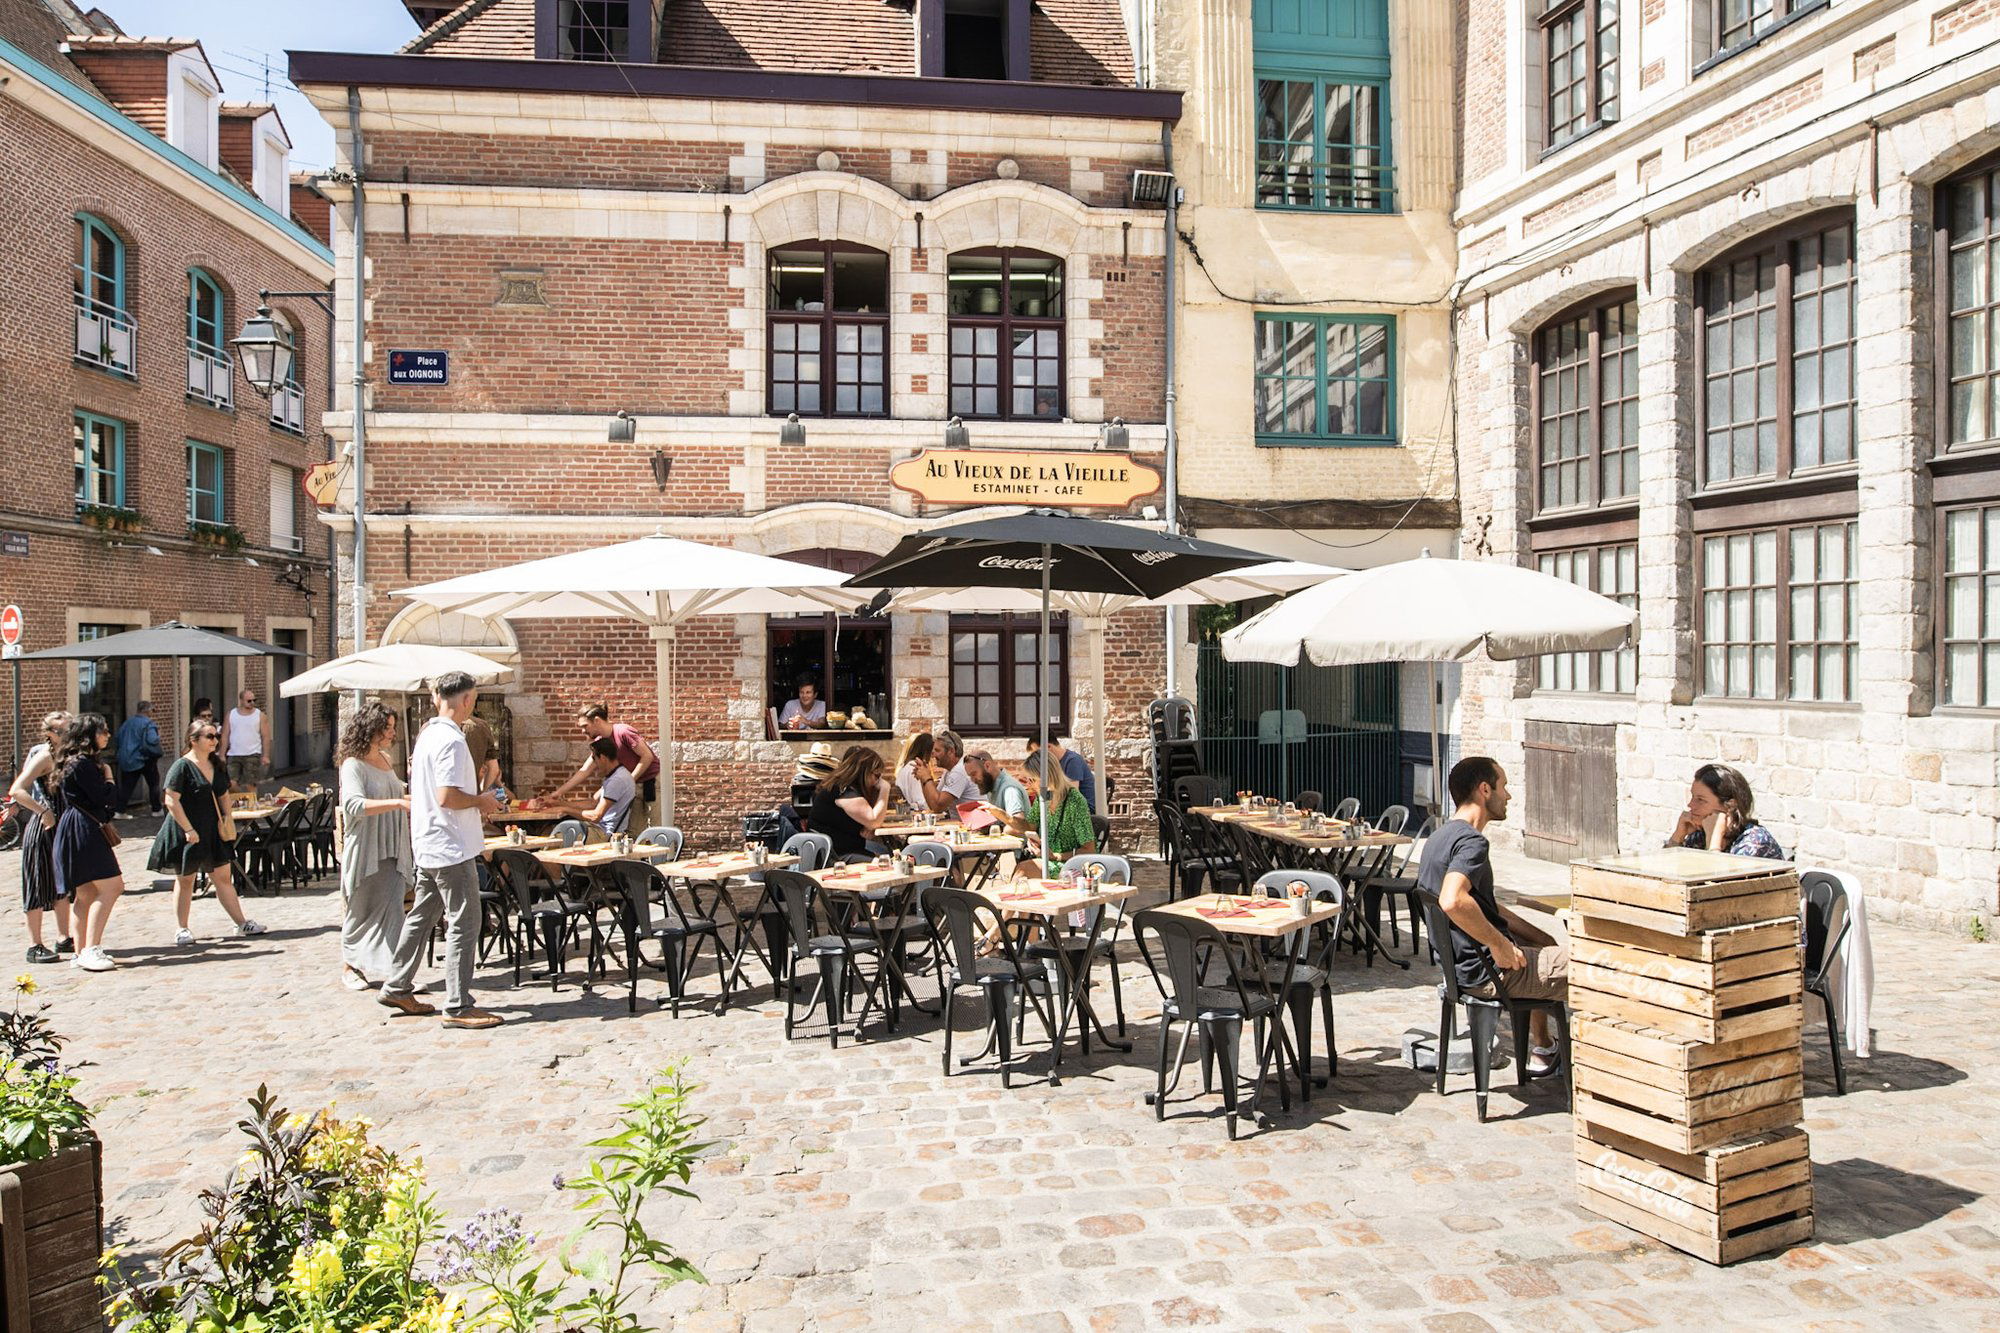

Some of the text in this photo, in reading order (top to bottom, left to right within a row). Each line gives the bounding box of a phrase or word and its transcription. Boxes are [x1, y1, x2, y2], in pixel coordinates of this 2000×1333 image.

[417, 356, 438, 366] Place
[409, 369, 443, 379] OIGNONS
[926, 459, 1130, 483] AU VIEUX DE LA VIEILLE
[973, 483, 1039, 495] ESTAMINET
[1055, 485, 1083, 496] CAFE
